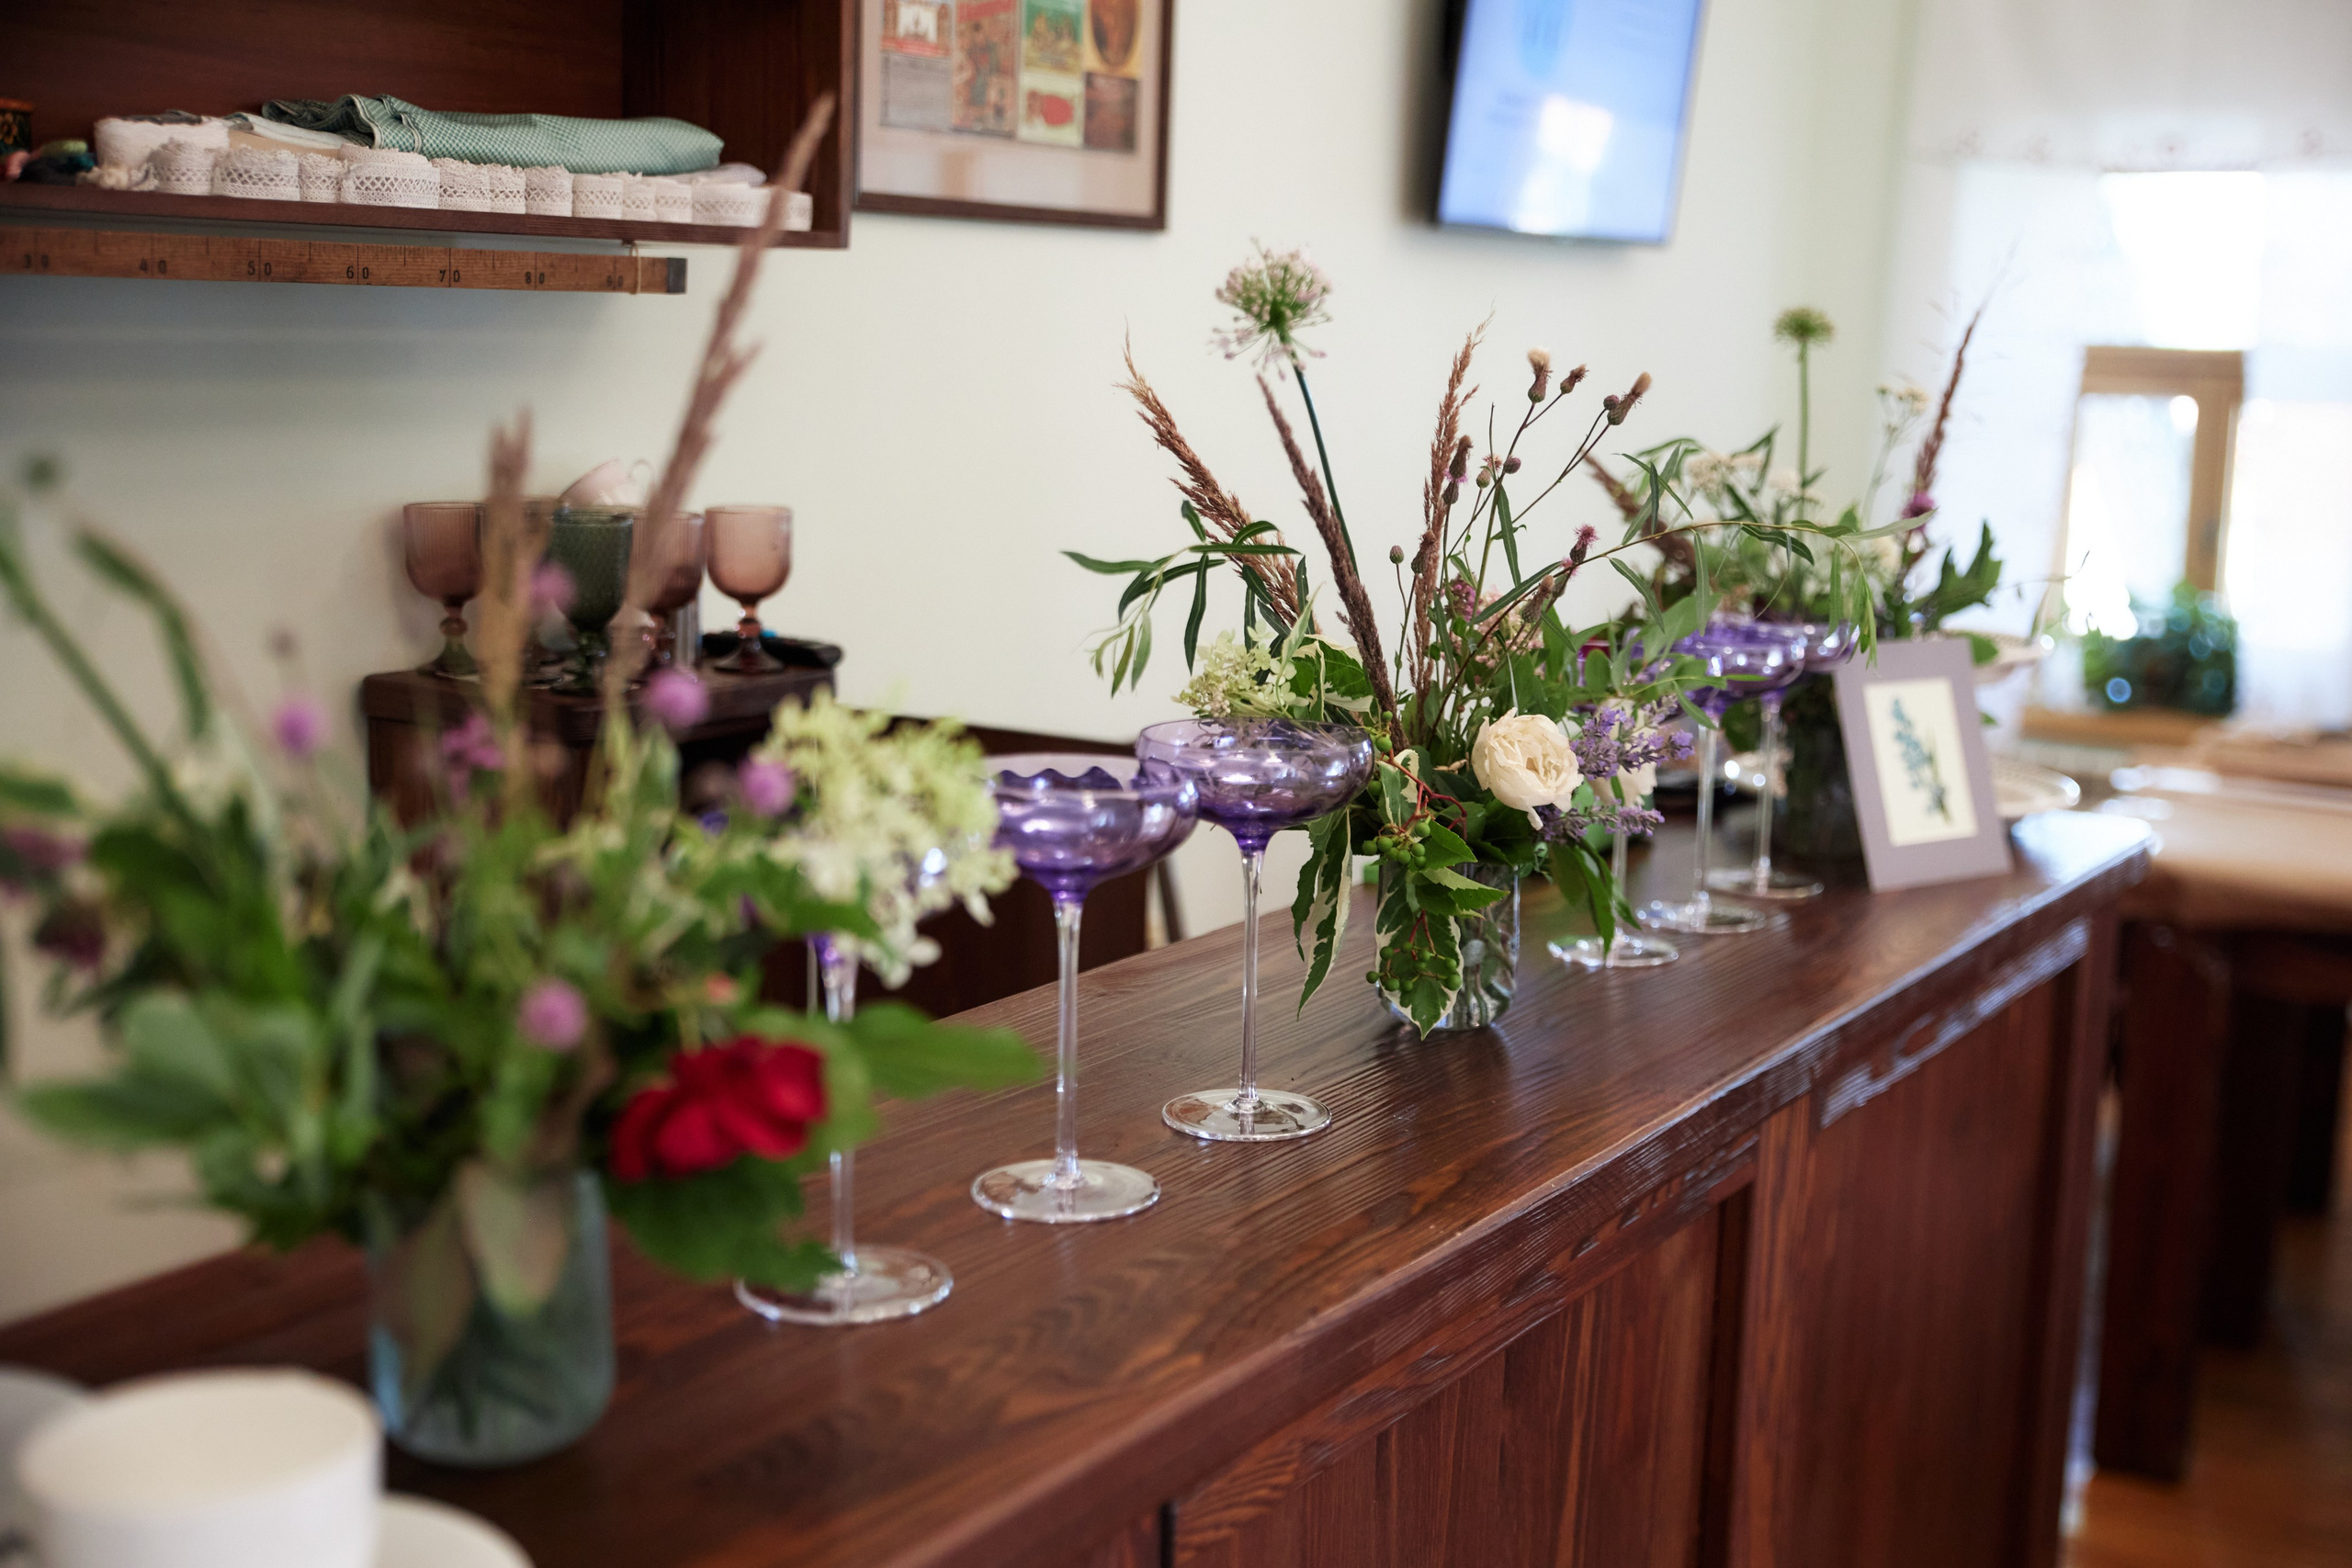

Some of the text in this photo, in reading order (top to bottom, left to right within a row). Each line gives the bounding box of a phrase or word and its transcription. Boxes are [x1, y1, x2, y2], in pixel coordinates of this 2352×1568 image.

[246, 261, 273, 276] 50
[345, 265, 369, 279] 60
[438, 268, 461, 283] 70
[524, 270, 546, 285] 80
